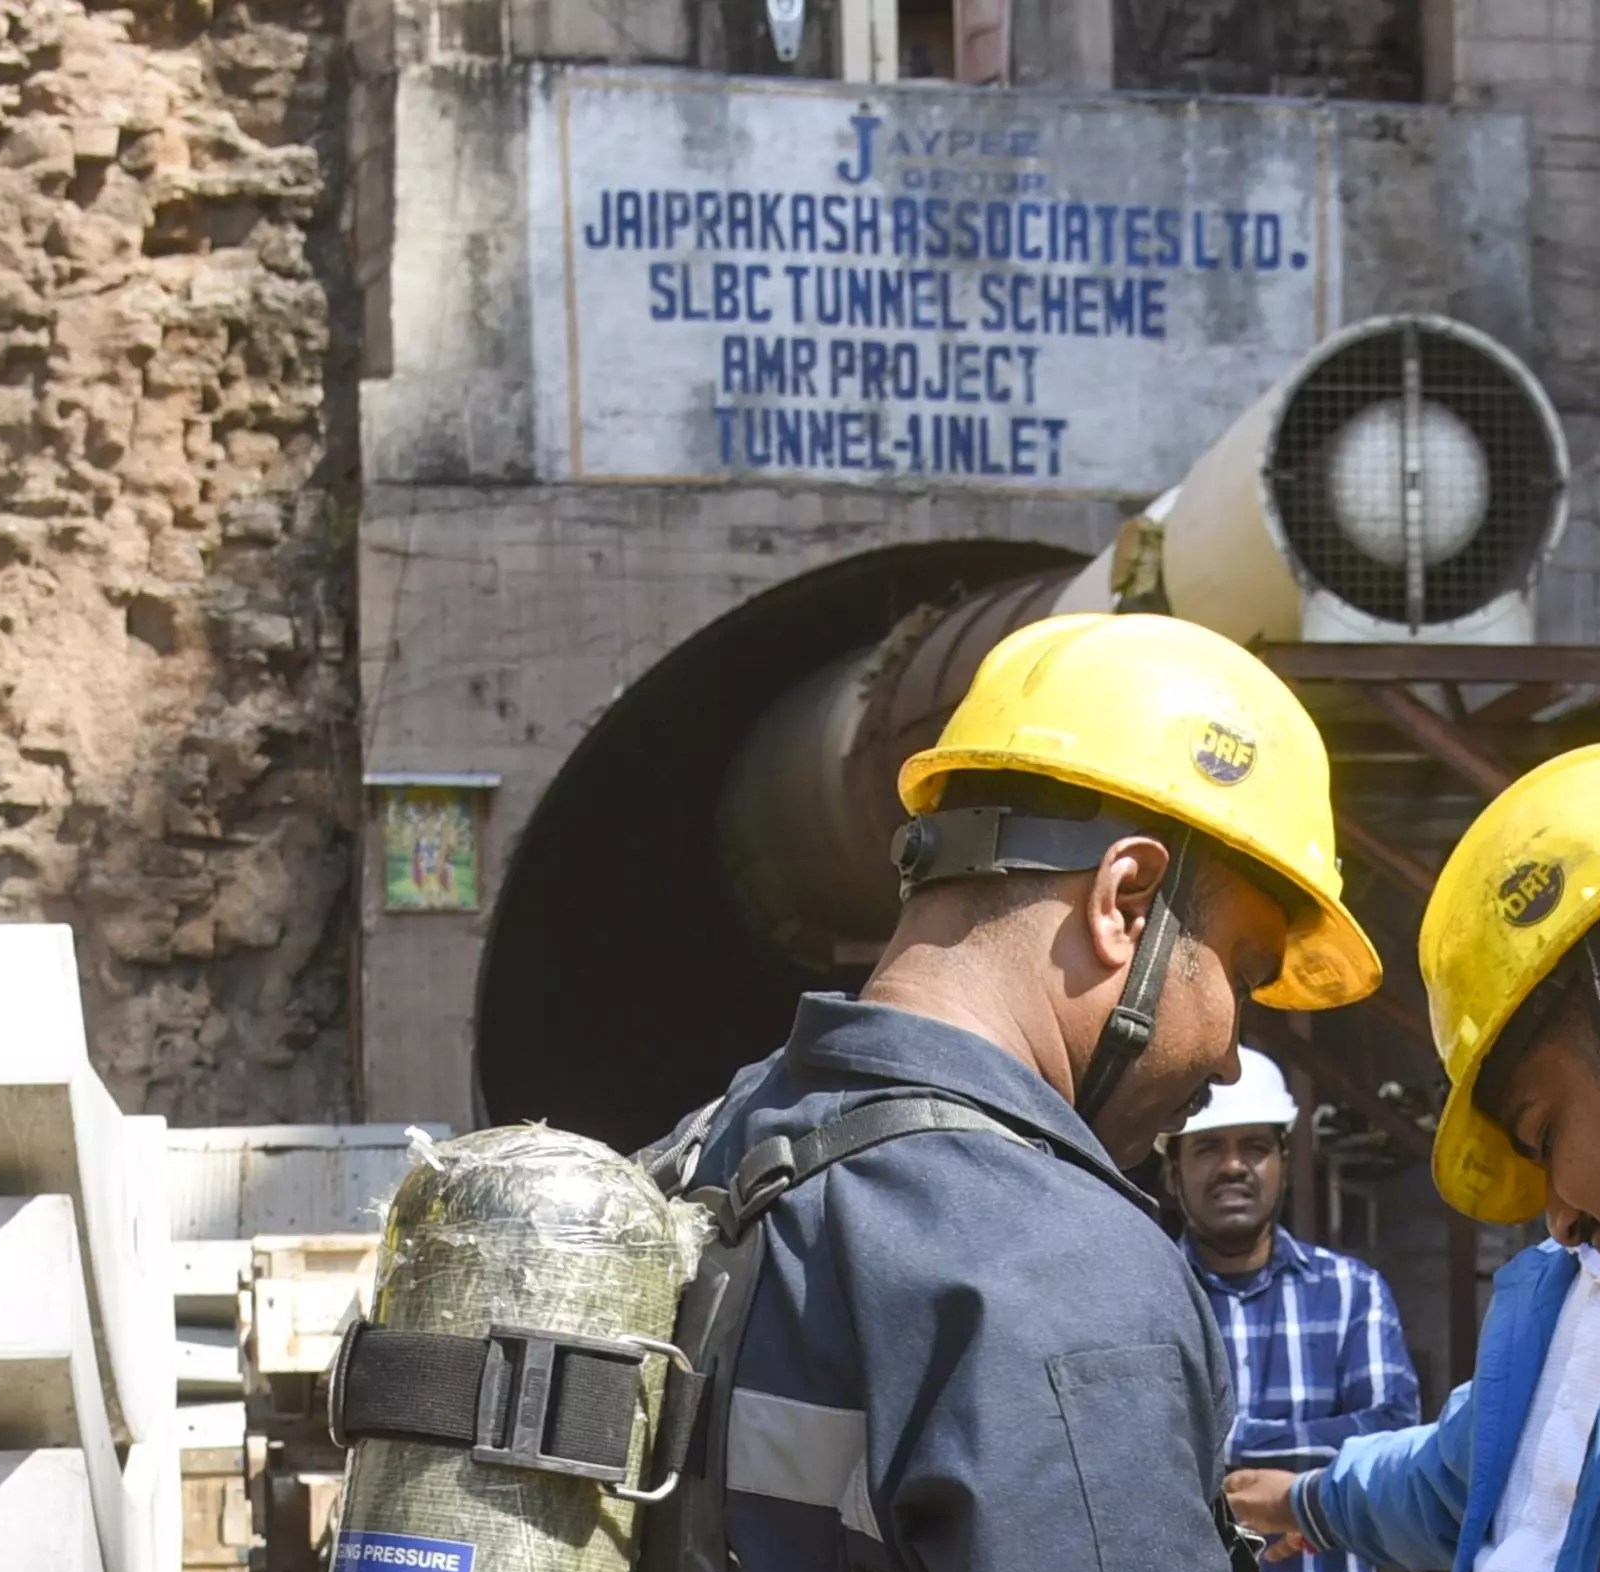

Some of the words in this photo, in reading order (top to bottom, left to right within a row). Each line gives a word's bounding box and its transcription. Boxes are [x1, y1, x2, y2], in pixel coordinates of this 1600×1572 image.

[584, 190, 880, 256] JAIPRAKASH
[891, 195, 1183, 267] ASSOCIATES
[1193, 210, 1309, 271] LTD.
[649, 262, 774, 323] SLBC
[784, 265, 967, 331] TUNNEL
[979, 275, 1166, 339] SCHEME
[722, 334, 818, 398] AMR
[829, 338, 1042, 404] PROJECT
[932, 412, 1068, 477] INLET
[1502, 862, 1551, 919] DRF
[363, 1544, 462, 1572] PRESSURE
